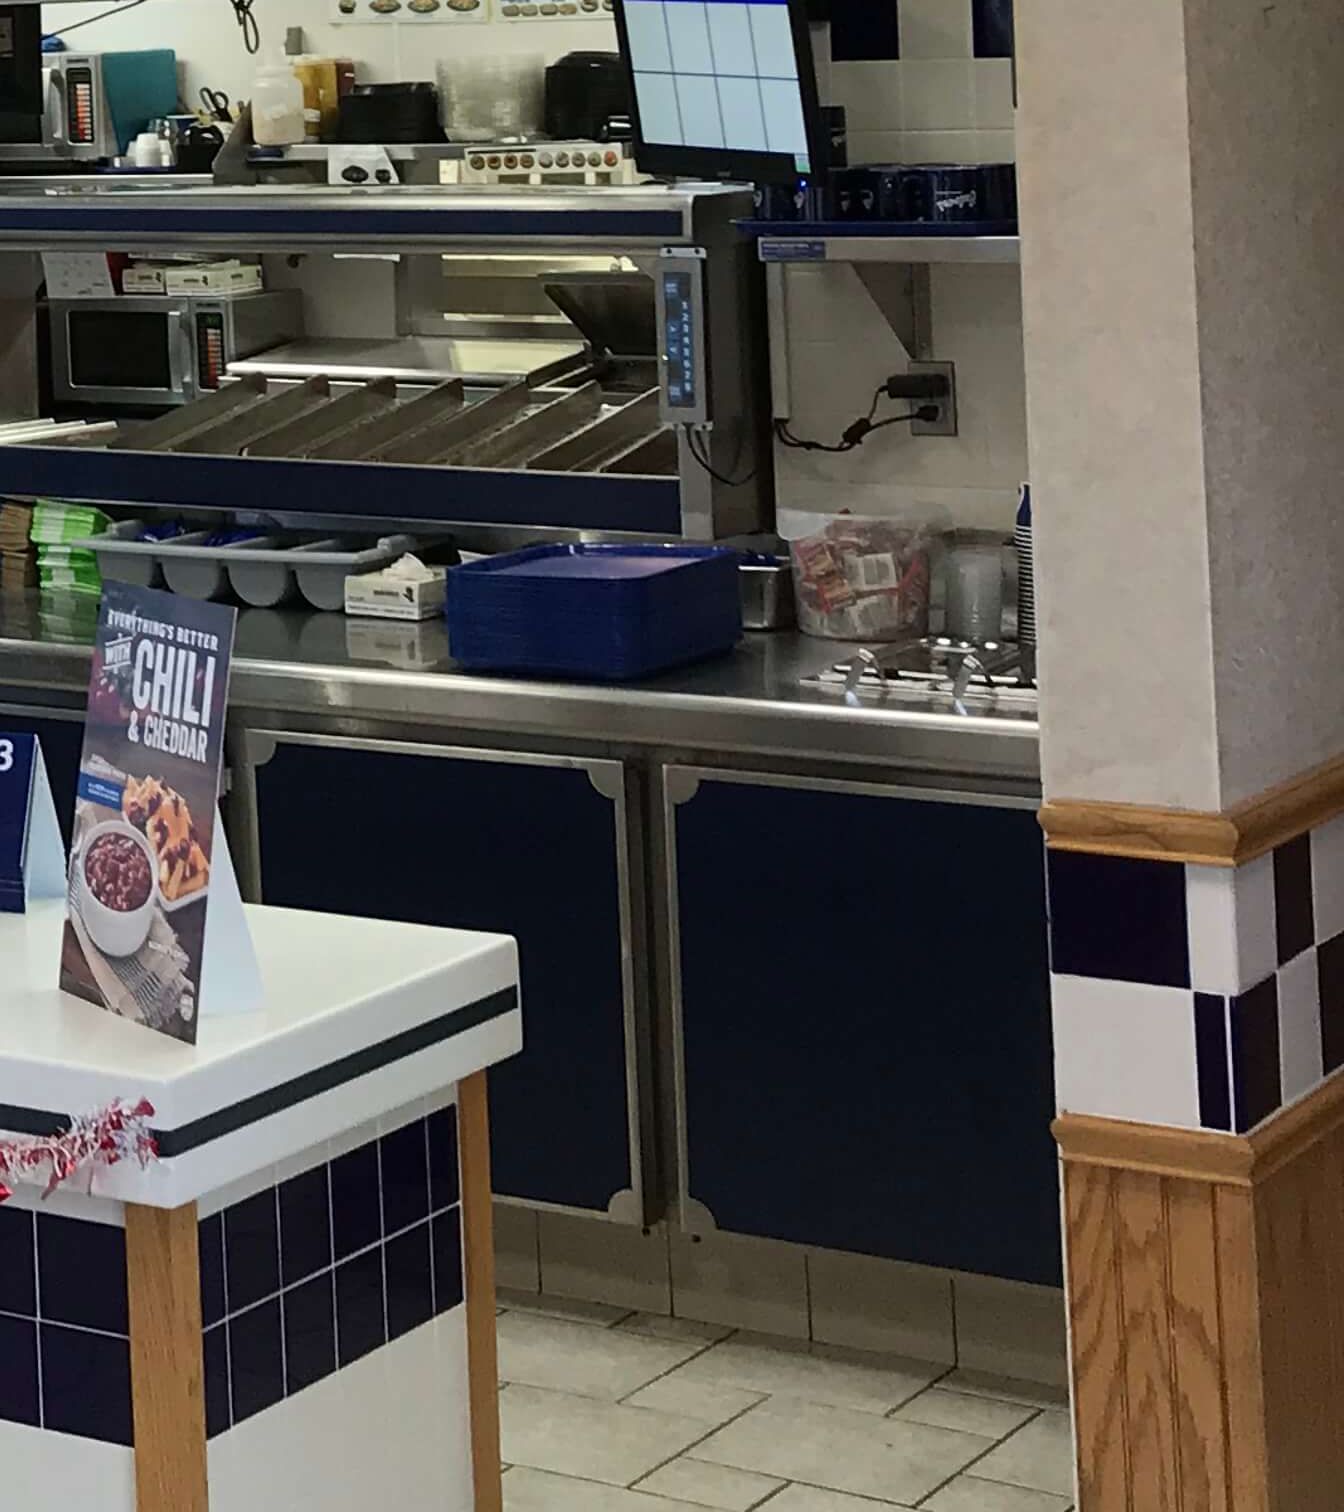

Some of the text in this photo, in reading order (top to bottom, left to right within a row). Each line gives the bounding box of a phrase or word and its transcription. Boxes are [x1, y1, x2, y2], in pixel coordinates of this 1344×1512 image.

[105, 643, 132, 666] WITH
[108, 608, 219, 652] EVERYTHING'S BETTER
[132, 639, 216, 728] CHILI
[127, 710, 208, 764] & CHEDDAR
